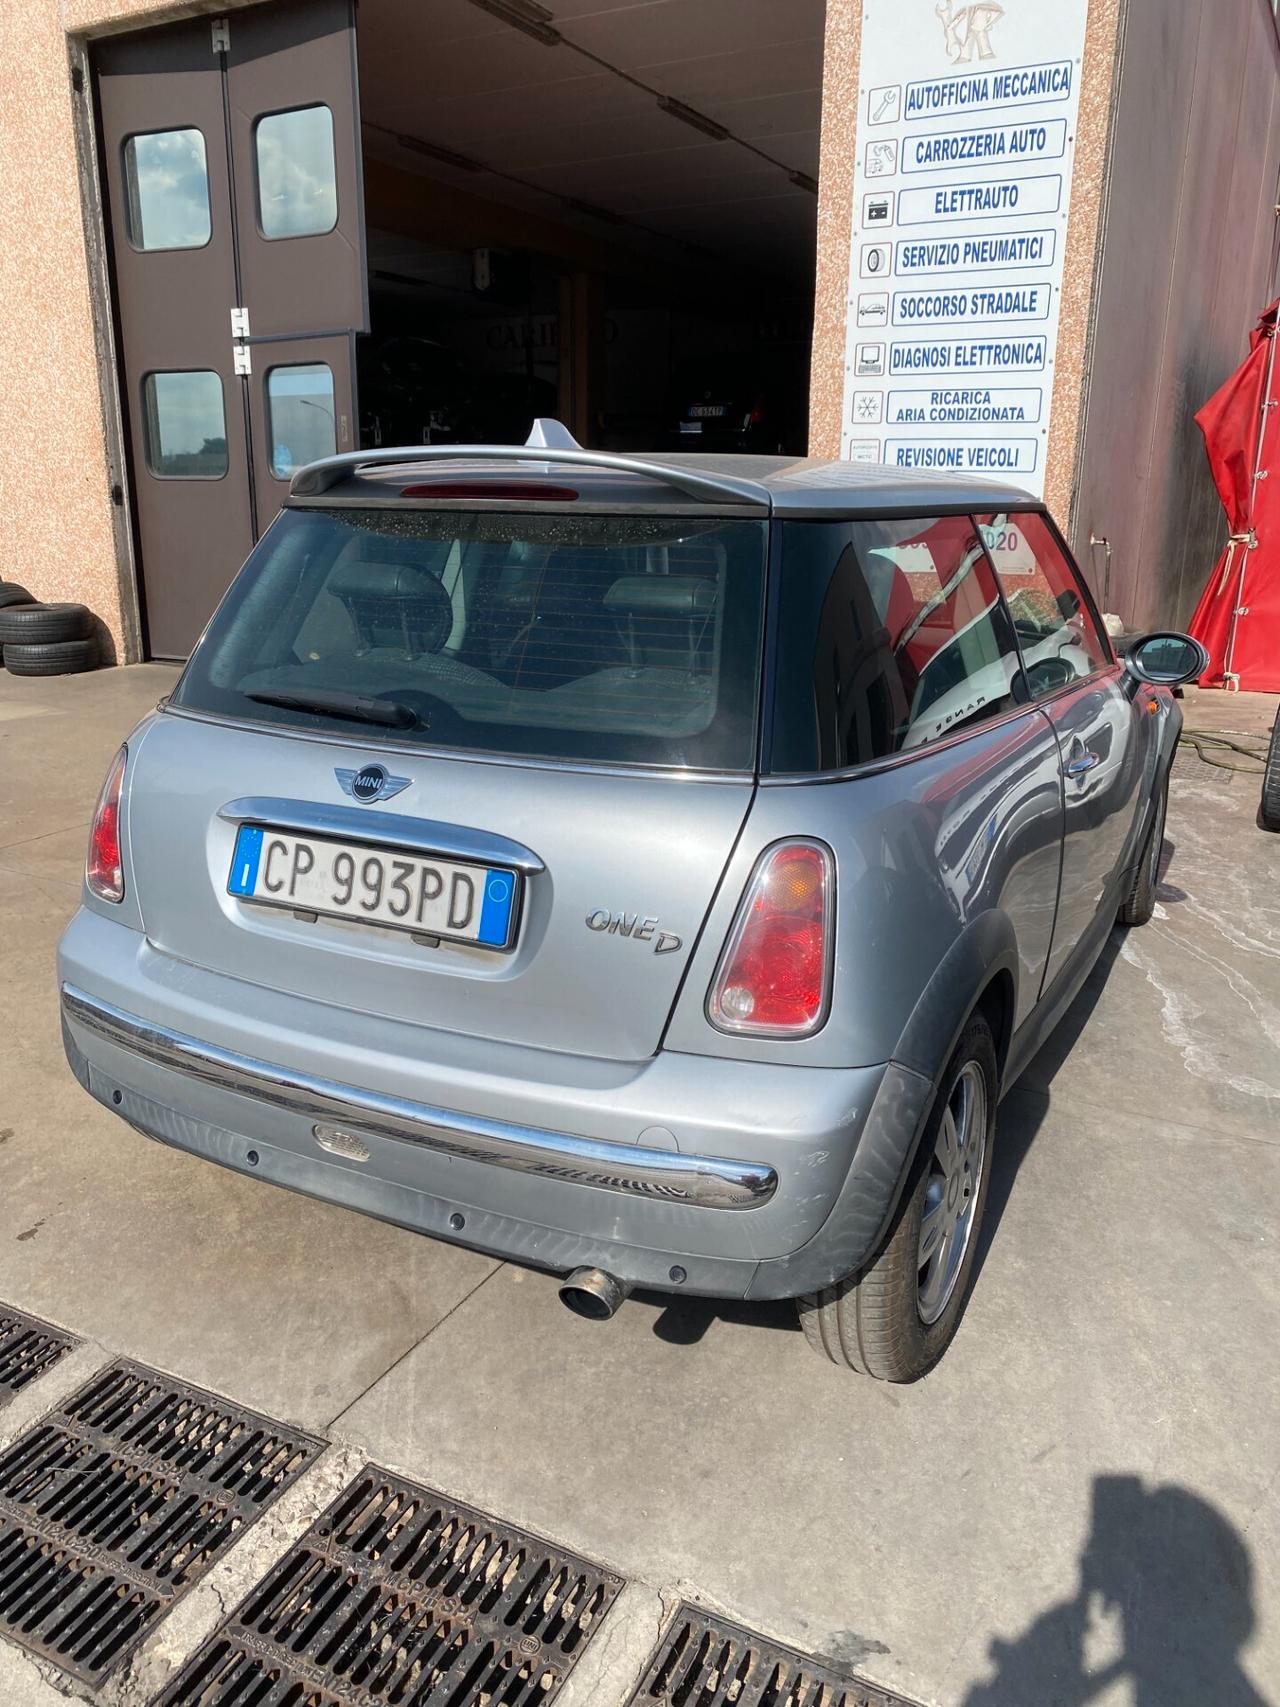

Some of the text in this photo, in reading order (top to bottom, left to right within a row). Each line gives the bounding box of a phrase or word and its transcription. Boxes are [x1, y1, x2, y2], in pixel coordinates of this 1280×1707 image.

[907, 66, 1069, 111] AUTOFFICINA MECCANICA
[915, 127, 1047, 164] CARROZZERIA AUTO
[934, 184, 1019, 214] ELETTRAUTO
[901, 236, 1044, 268] SERVIZIO PNEUMATICI
[899, 290, 1038, 319] SOCCORSO STRADALE
[892, 342, 1043, 369] DIAGNOSI ELETTRONICA
[930, 391, 991, 405] RICARICA
[896, 406, 1025, 422] ARIA CONDIZIONATA
[896, 447, 1019, 467] REVISIONE VEICOLI
[354, 775, 383, 789] MINI
[263, 839, 314, 897] CP
[330, 851, 476, 930] 993PD
